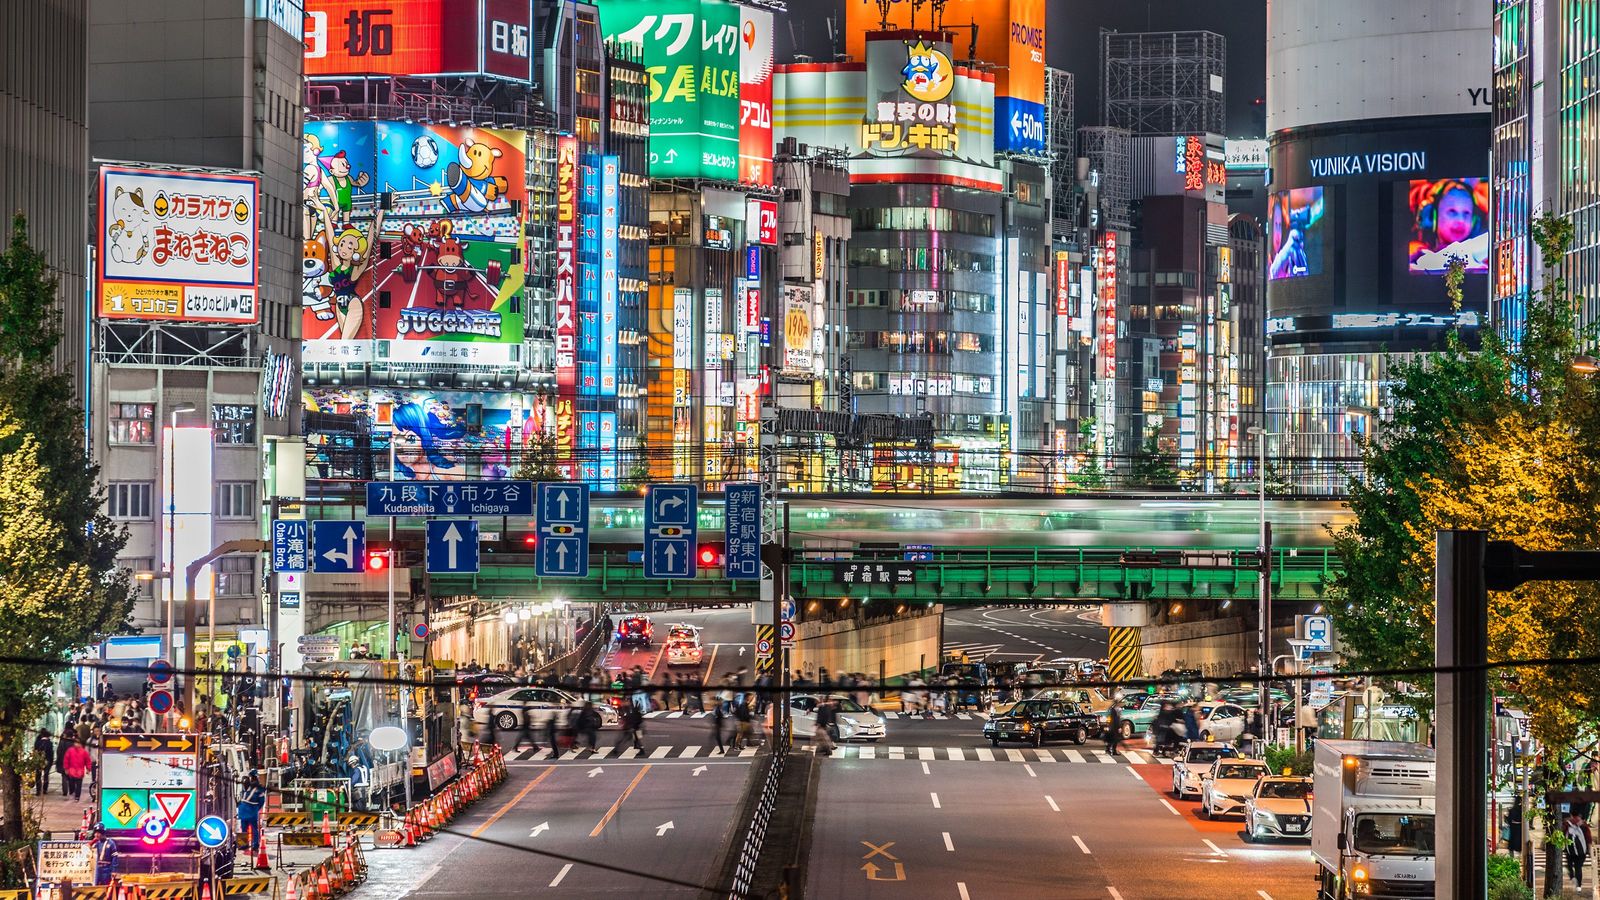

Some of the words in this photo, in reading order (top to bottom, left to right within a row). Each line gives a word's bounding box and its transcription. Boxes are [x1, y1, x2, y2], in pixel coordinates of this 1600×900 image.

[603, 13, 694, 56] イク
[702, 19, 738, 56] レイク
[1011, 21, 1042, 49] PROMISE
[701, 65, 738, 99] ALSA
[740, 100, 770, 129] アコム
[1022, 112, 1043, 141] 50m
[1310, 158, 1362, 177] YUNIKA
[1366, 152, 1425, 173] VISION
[558, 145, 574, 222] パチンコ
[170, 195, 233, 219] カラオケ
[151, 224, 250, 267] まねきねこ
[130, 298, 178, 314] ワンカラ
[187, 293, 230, 313] となりのビル
[240, 296, 252, 313] 4F
[396, 308, 502, 337] JUGGLER
[675, 304, 685, 357] 小松ビル
[449, 348, 479, 358] 北電子
[380, 485, 440, 502] 九段下
[384, 503, 435, 513] Kudanshita
[471, 503, 510, 513] Ichigaya
[729, 491, 740, 536] Shinjuku
[276, 523, 286, 545] Otaki
[741, 489, 756, 574] 新宿駅東口
[276, 547, 286, 569] Brdg.
[287, 523, 305, 569] 小滝橋
[843, 571, 890, 583] 新宿駅
[850, 564, 883, 572] 中央線
